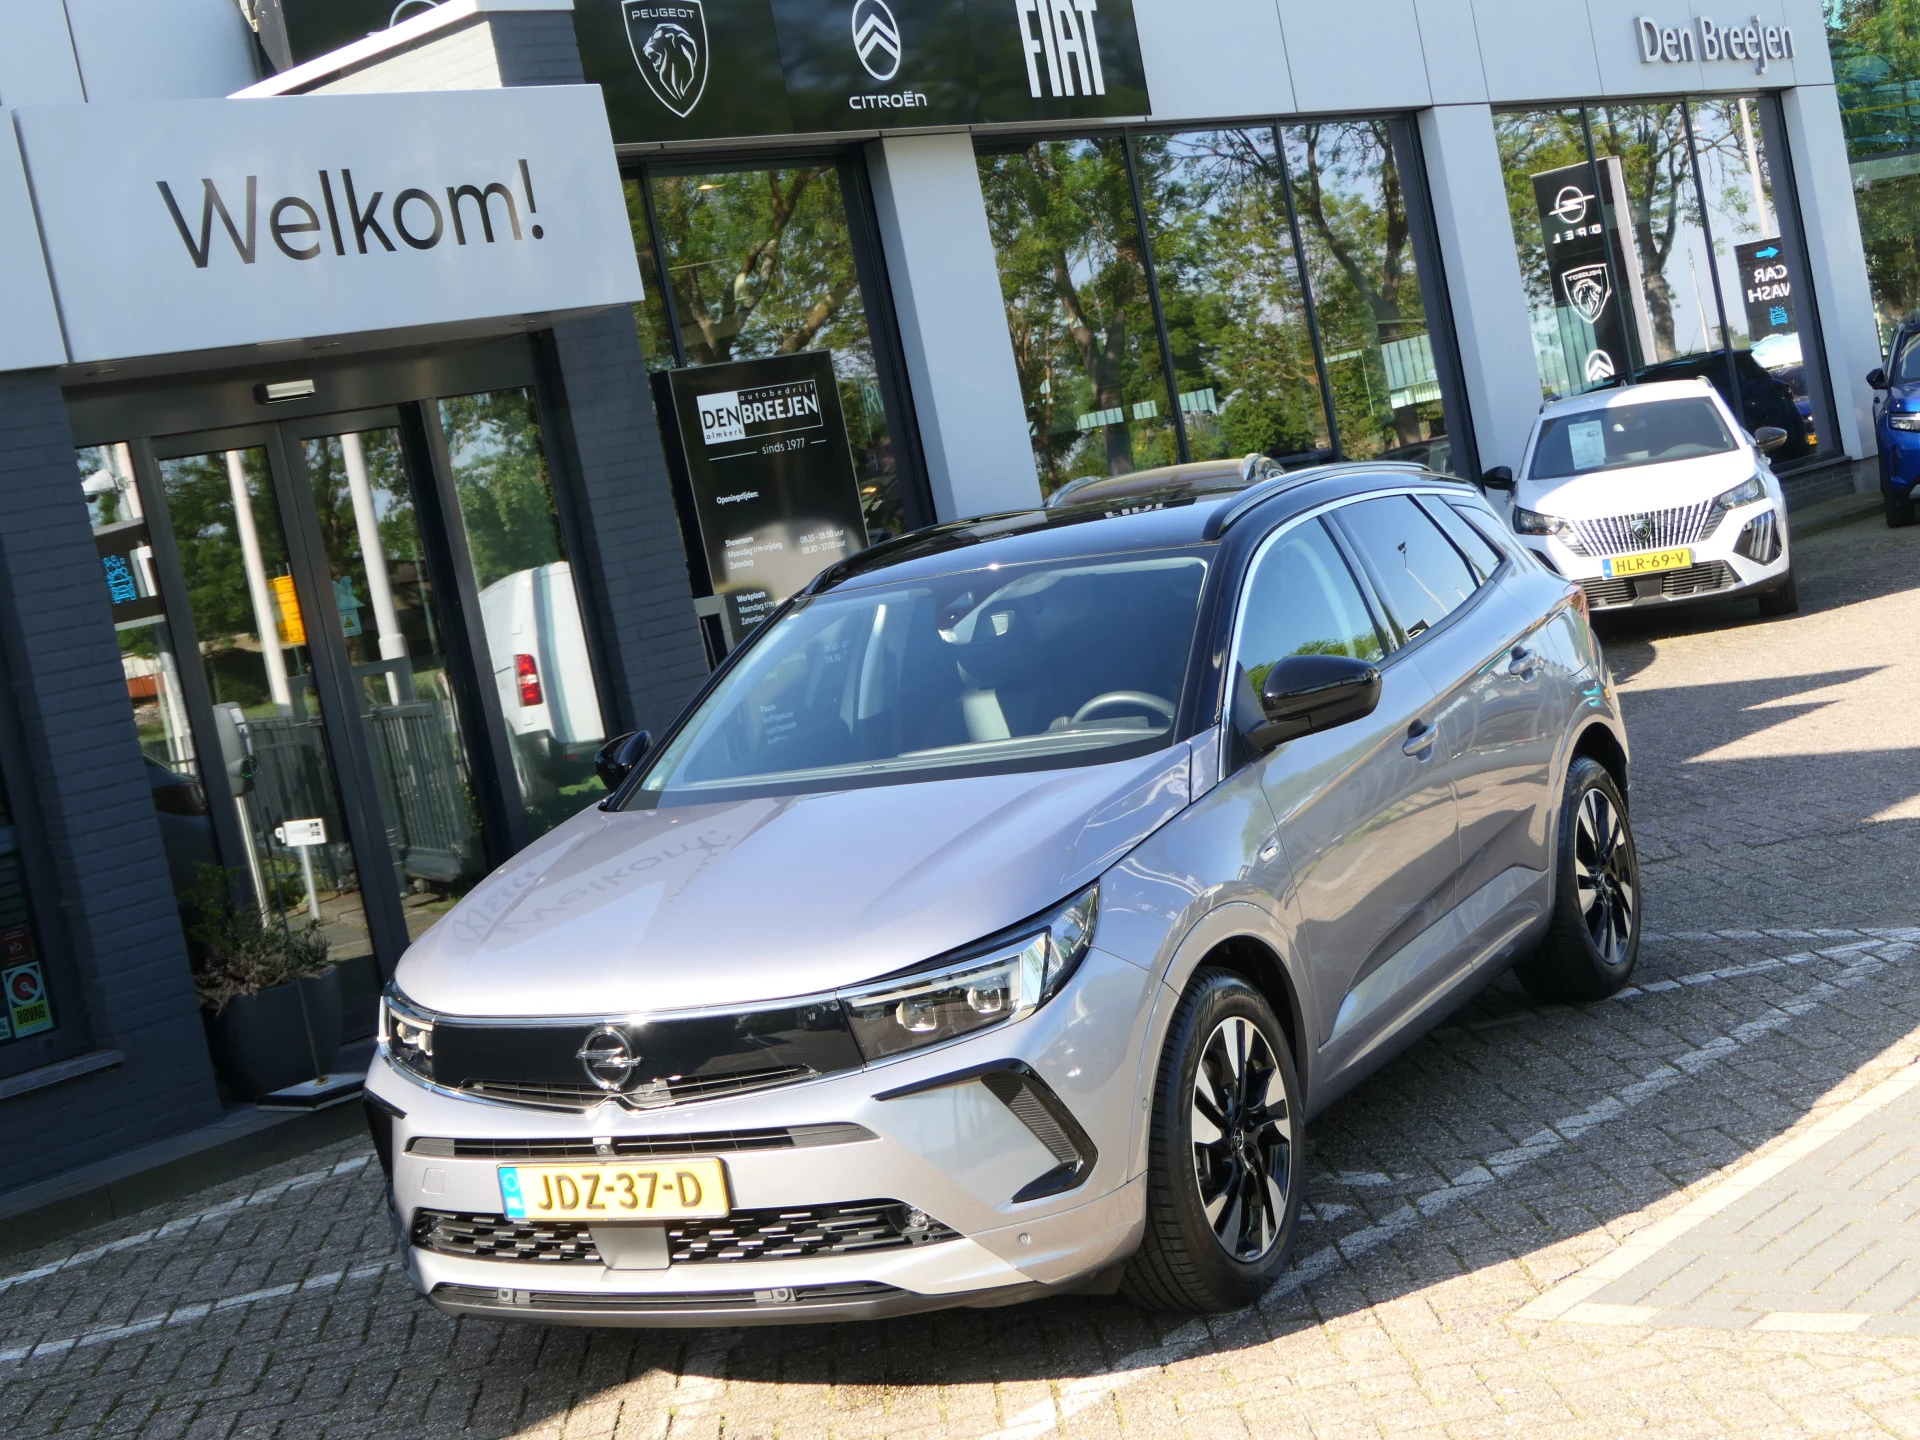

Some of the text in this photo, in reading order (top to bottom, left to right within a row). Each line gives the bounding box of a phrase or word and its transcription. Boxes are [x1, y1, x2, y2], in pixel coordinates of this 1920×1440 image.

[631, 8, 694, 20] PEUGEOT
[1015, 0, 1105, 98] FIAT
[1633, 14, 1796, 75] Den Breejen
[155, 158, 544, 269] Welkom!
[740, 383, 814, 401] autobedrijf
[702, 394, 819, 430] DEN BREEJEN
[706, 428, 743, 440] almkerk
[761, 438, 805, 455] sinds 1977
[725, 536, 754, 548] Showroom
[727, 547, 753, 559] Maandag
[764, 541, 783, 553] vrijdag
[729, 558, 754, 570] Zaterdag
[1616, 552, 1684, 573] HLR-69-V
[736, 591, 766, 603] Werkplaats
[739, 602, 765, 614] Maandag
[16, 1006, 46, 1024] BOVAG
[538, 1170, 702, 1210] JDZ-37-D
